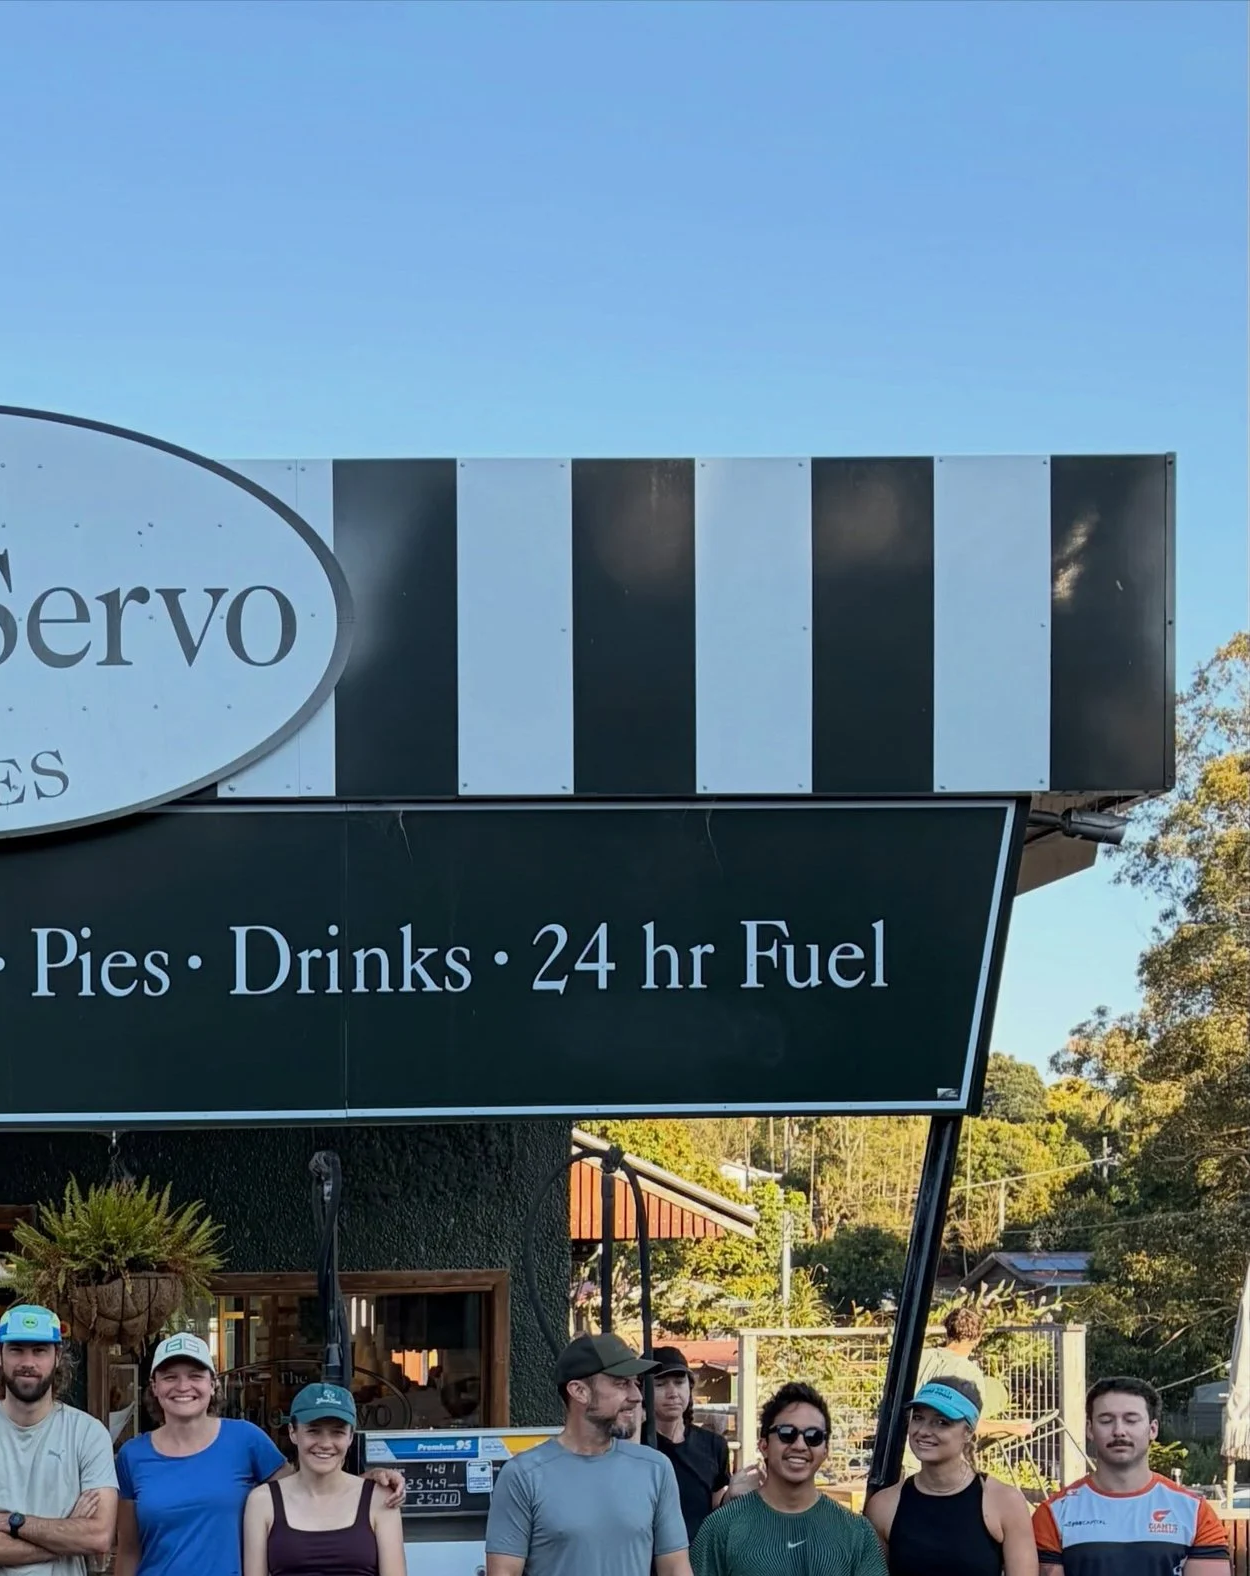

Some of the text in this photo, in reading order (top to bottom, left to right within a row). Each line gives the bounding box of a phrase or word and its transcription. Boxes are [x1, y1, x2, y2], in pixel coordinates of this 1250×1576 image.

[31, 926, 171, 997] Pies
[229, 923, 473, 996] Drinks
[531, 921, 616, 995] 24
[641, 920, 715, 990] hr
[740, 918, 889, 989] Fuel
[417, 1443, 455, 1451] Premium
[455, 1439, 472, 1450] 95
